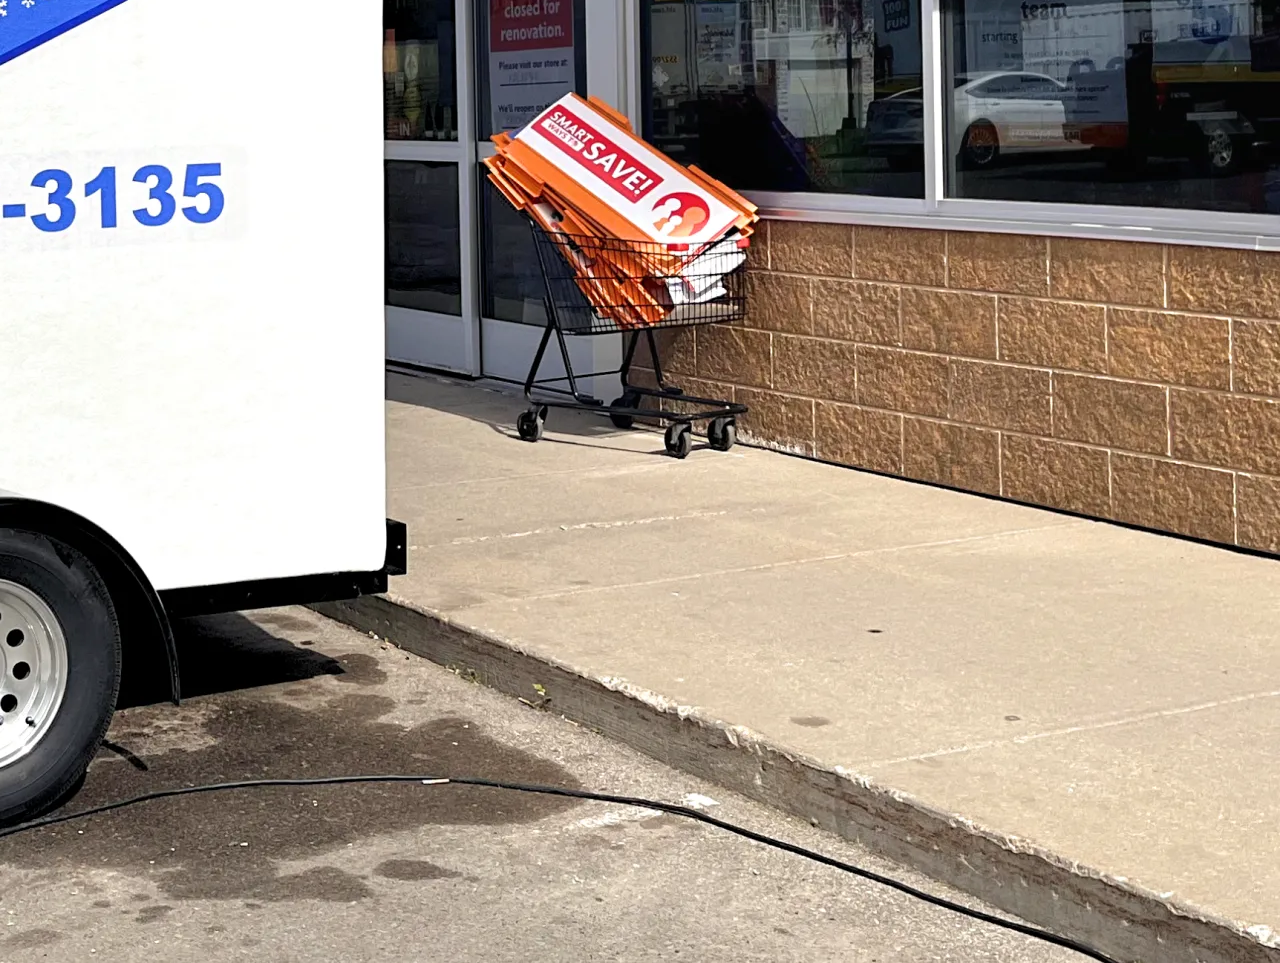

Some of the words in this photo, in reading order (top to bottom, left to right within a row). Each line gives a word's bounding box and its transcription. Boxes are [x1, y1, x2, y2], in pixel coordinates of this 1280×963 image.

[504, 1, 540, 19] closed
[1021, 0, 1069, 20] team
[886, 15, 909, 30] FUN
[500, 24, 565, 43] renovation.
[982, 31, 1018, 45] starting
[498, 61, 518, 70] Please
[532, 61, 542, 69] our
[544, 59, 560, 68] store
[497, 103, 513, 113] We'll
[514, 104, 534, 114] reopen
[548, 123, 567, 139] WAYS
[550, 111, 595, 143] SMART
[582, 142, 654, 195] SAVE!
